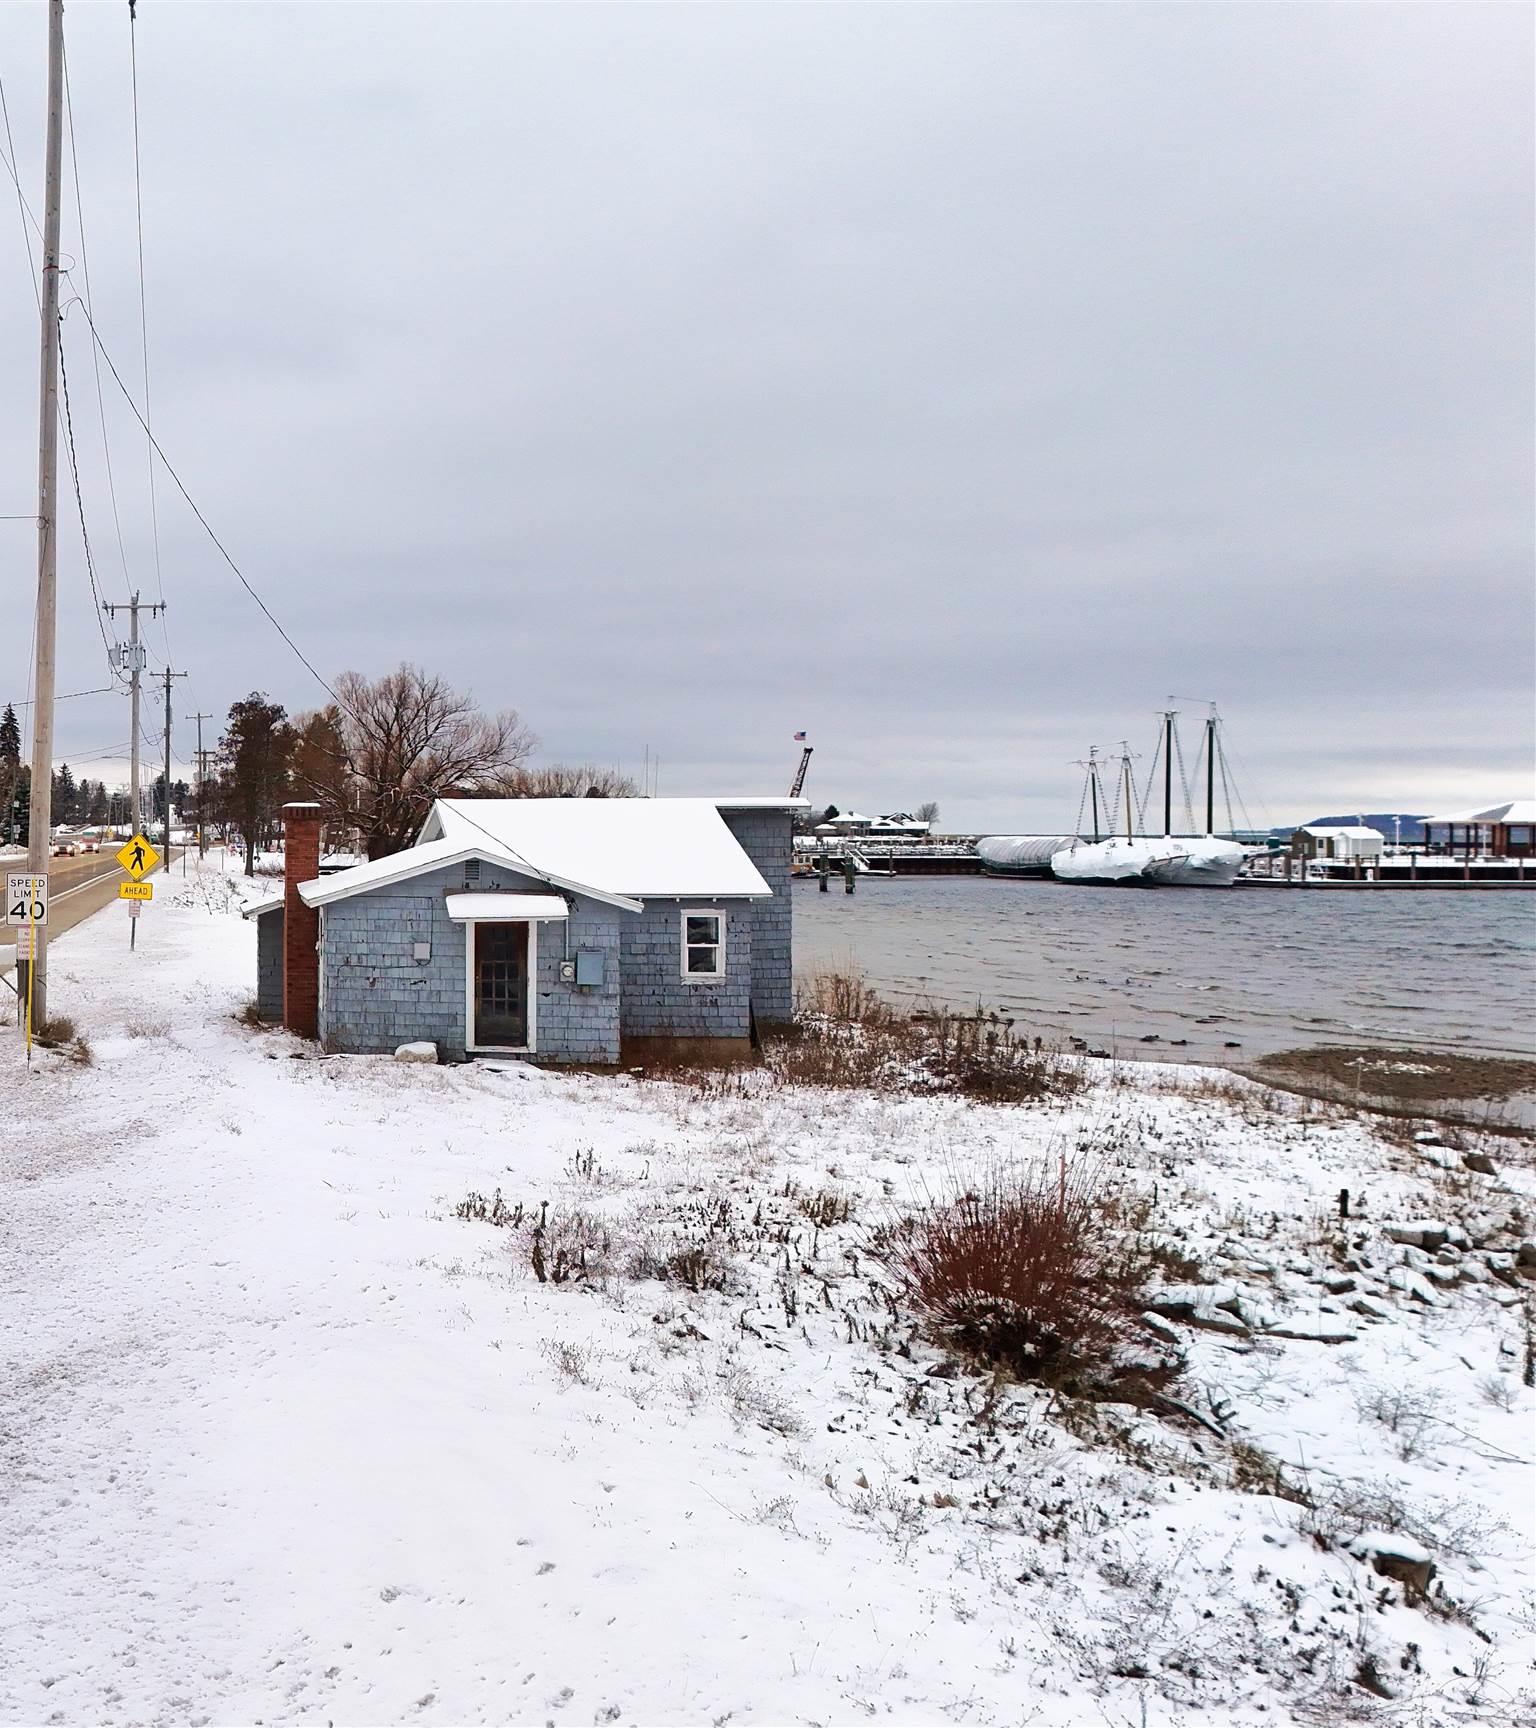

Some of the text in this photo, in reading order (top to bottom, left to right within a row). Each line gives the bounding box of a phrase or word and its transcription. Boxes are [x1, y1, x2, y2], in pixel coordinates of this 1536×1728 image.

[13, 890, 41, 898] LIMT
[124, 887, 148, 895] AHEAD
[9, 901, 45, 919] 40
